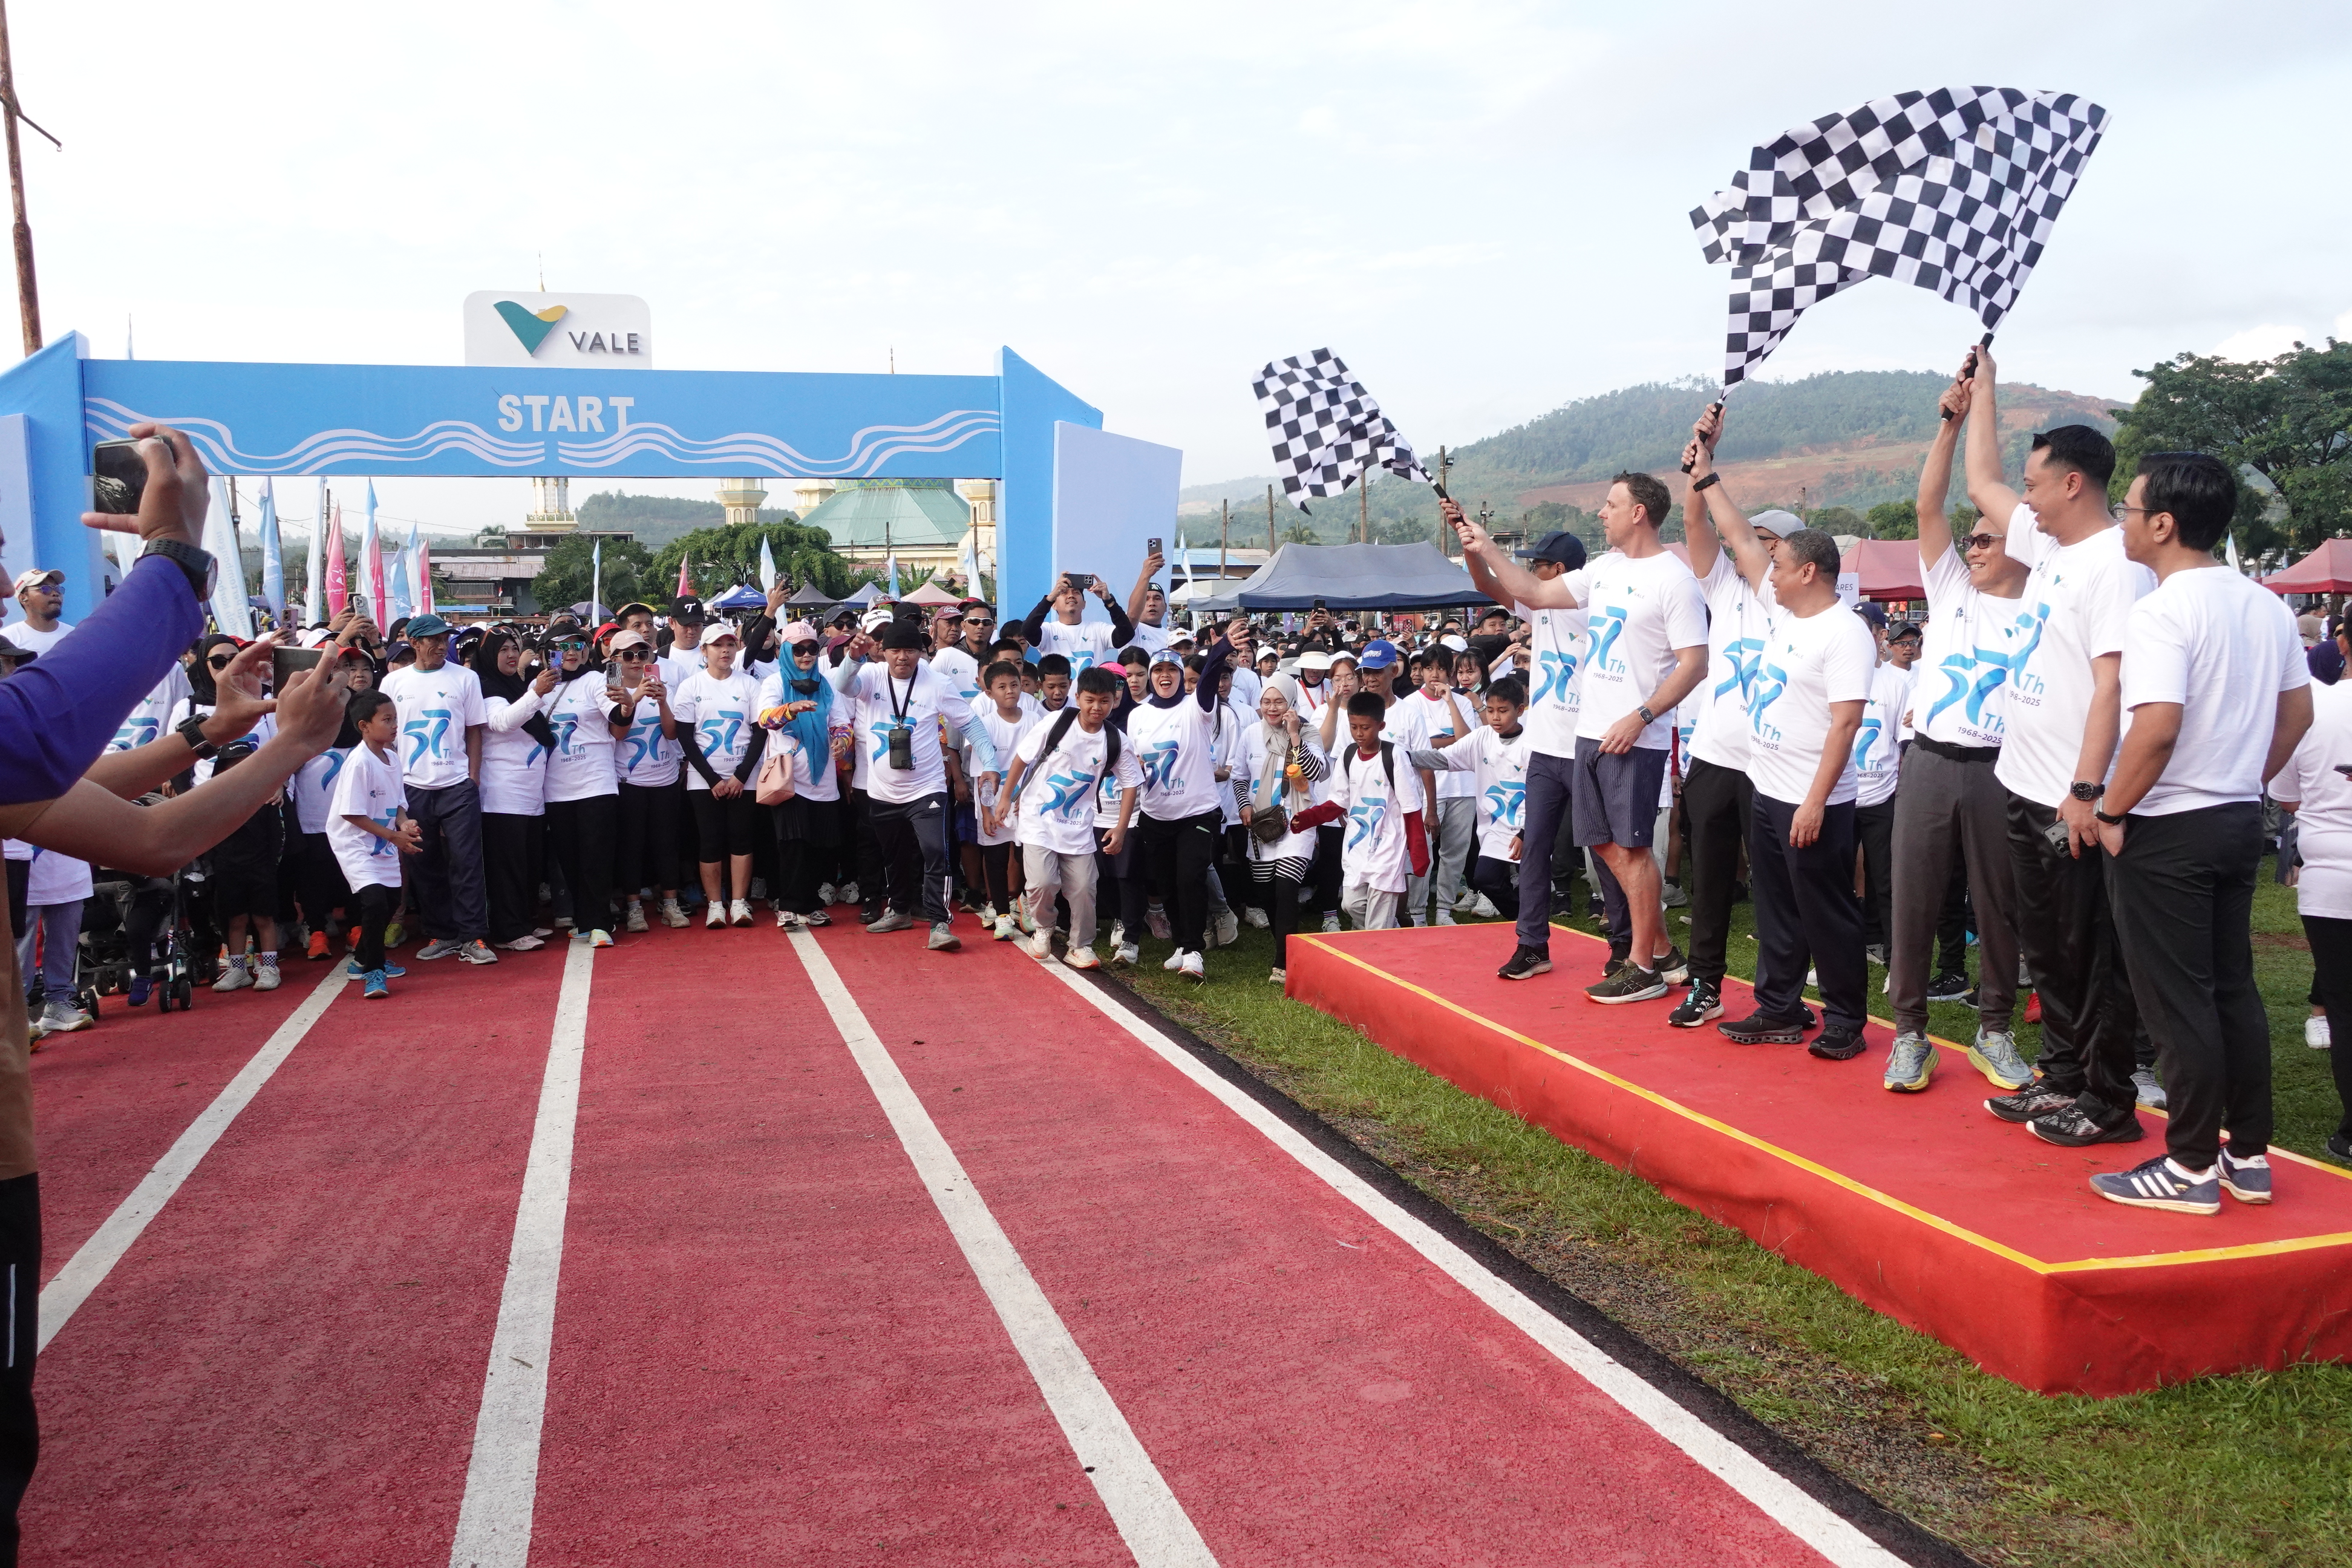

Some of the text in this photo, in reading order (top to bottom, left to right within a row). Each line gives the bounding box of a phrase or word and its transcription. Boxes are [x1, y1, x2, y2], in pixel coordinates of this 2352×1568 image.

[568, 332, 639, 352] VALE
[498, 394, 635, 433] START
[1593, 672, 1624, 683] 1968-2025
[1957, 726, 2002, 744] 1968-2025
